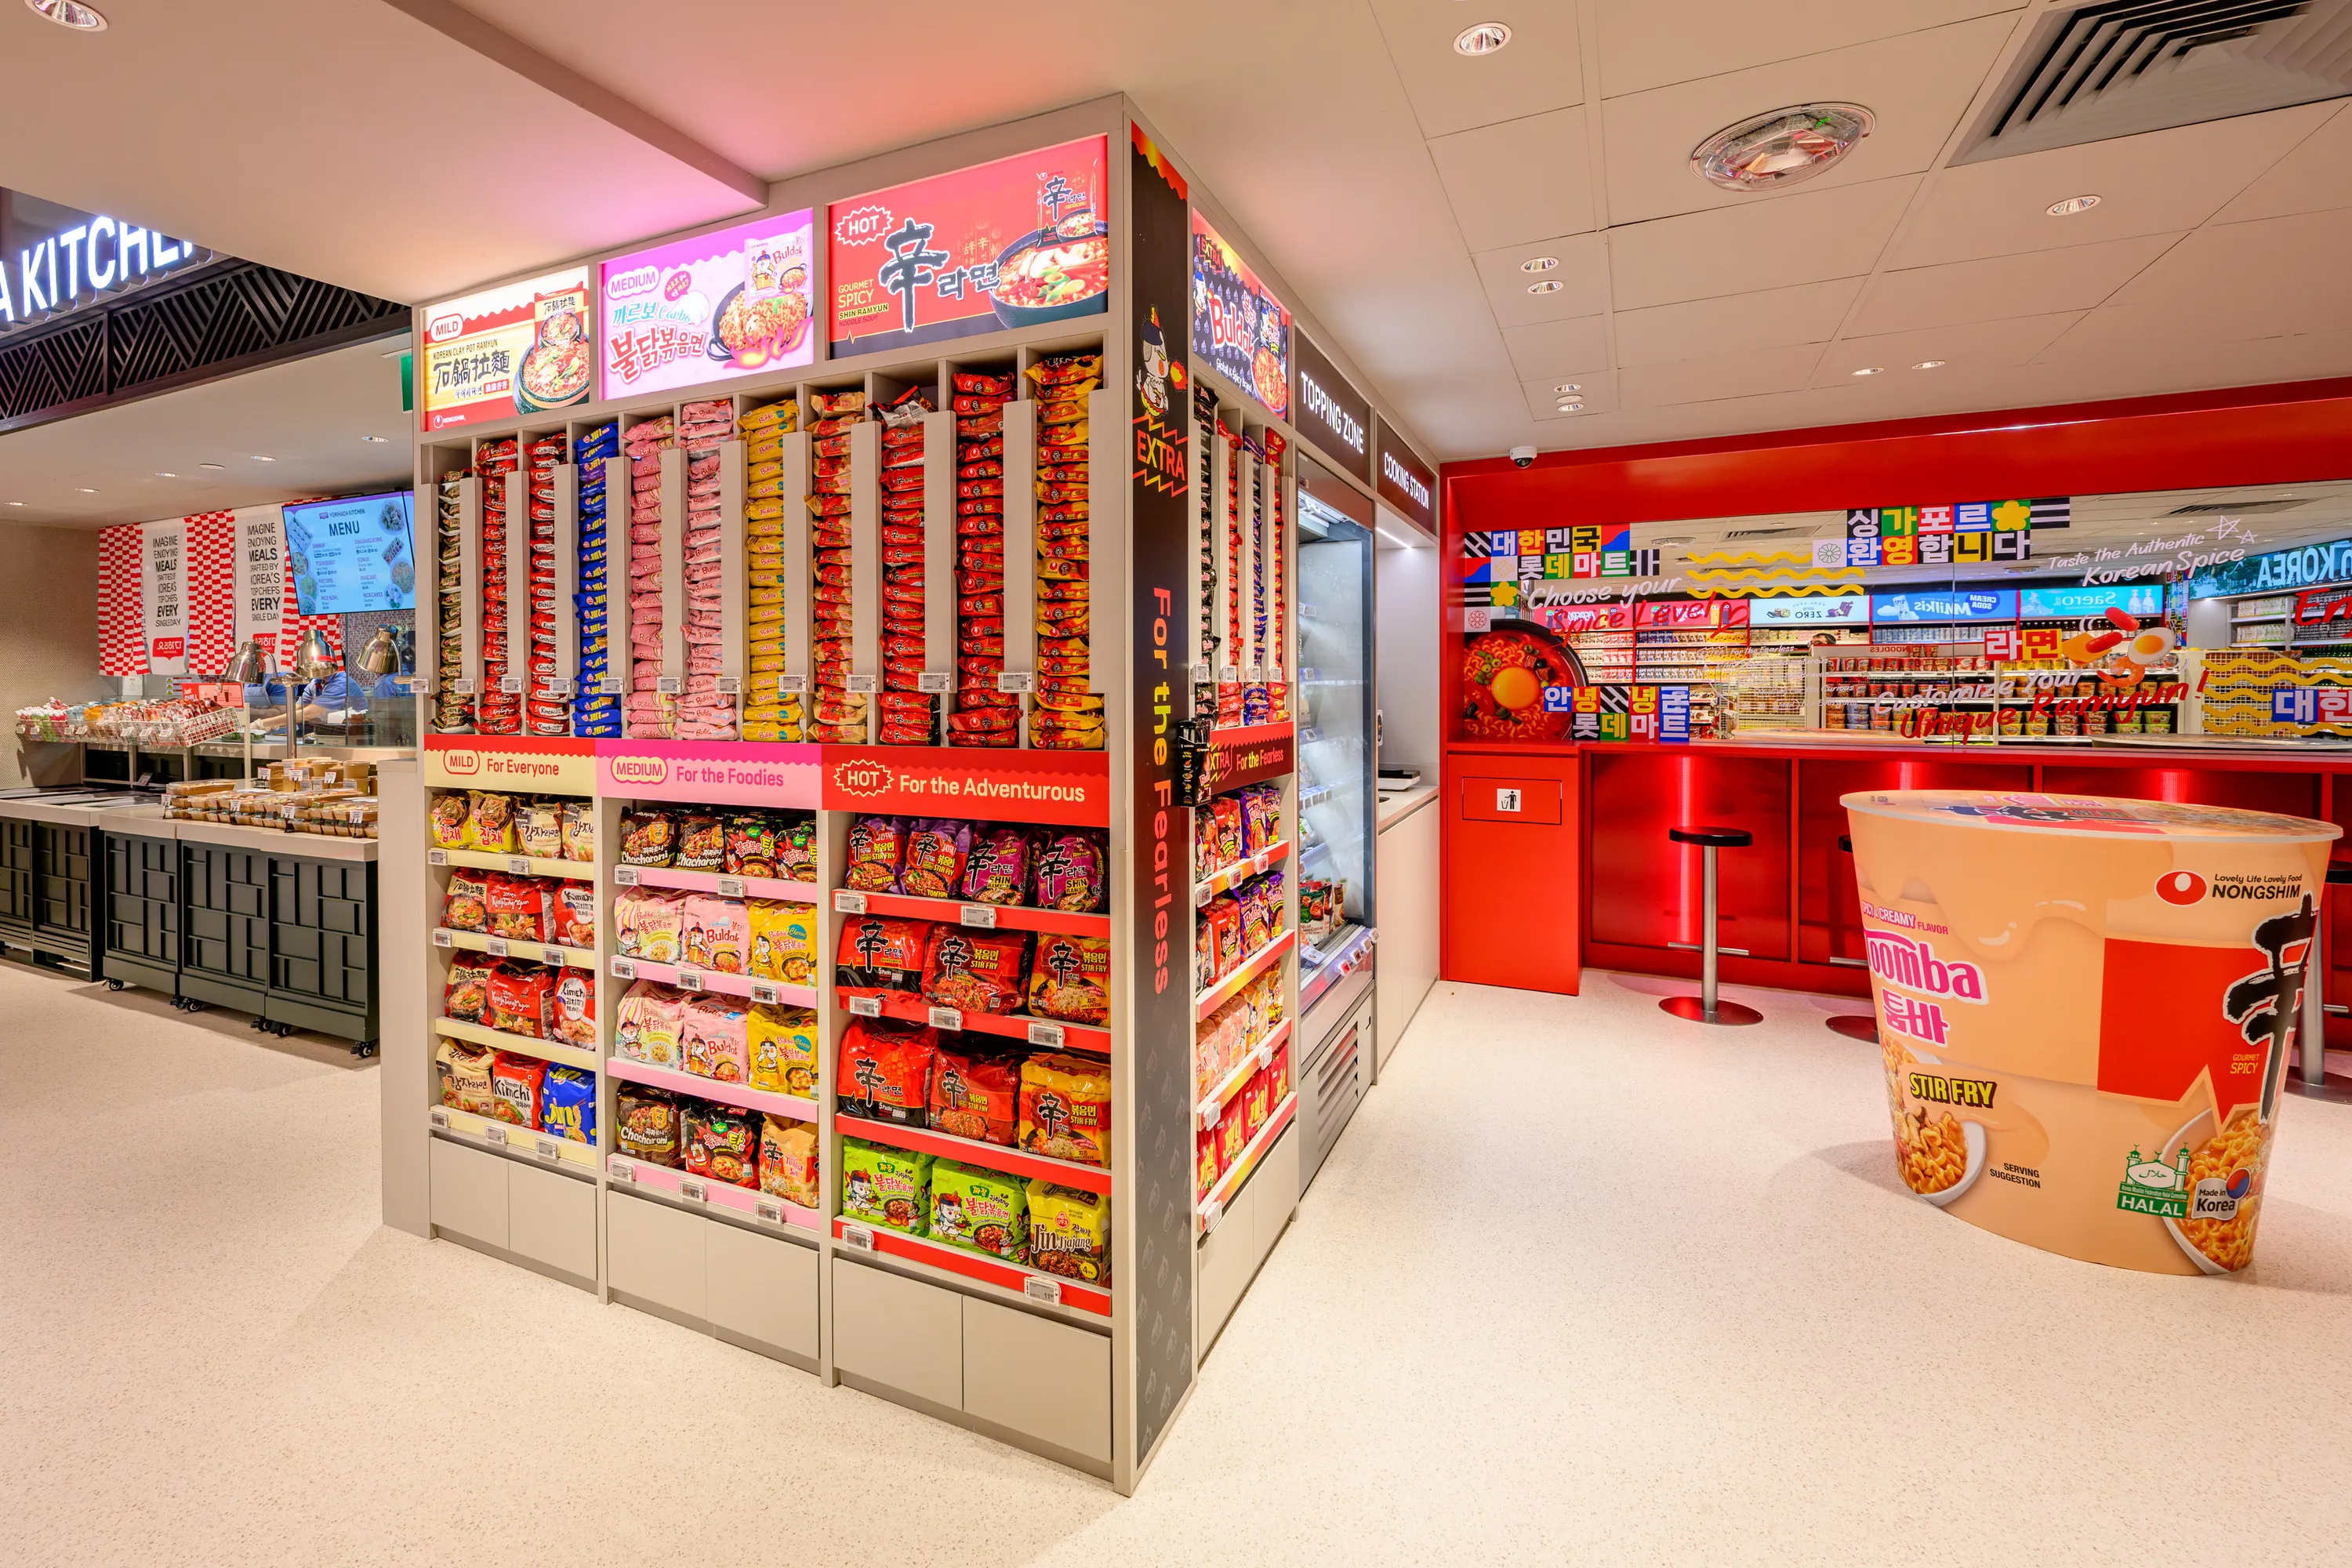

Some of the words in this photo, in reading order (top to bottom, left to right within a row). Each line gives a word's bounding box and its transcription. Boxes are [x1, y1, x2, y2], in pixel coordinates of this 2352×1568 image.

[1044, 176, 1073, 220] 辛
[849, 216, 880, 236] HOT
[611, 271, 656, 293] MEDIUM
[838, 279, 874, 293] GOURMET
[880, 219, 949, 331] 辛
[938, 263, 1000, 299] 라면
[838, 289, 874, 308] SPICY
[612, 302, 655, 325] 까르보
[839, 310, 856, 320] SHIN
[857, 304, 888, 316] RAMYUN
[862, 314, 878, 323] SOUP
[435, 321, 459, 336] MILD
[1210, 295, 1254, 359] Buldak
[433, 348, 452, 360] KOREAN
[452, 346, 465, 357] CLAY
[466, 343, 476, 354] POT
[477, 339, 499, 352] RAMYUN
[610, 327, 706, 381] 불닭볶음면
[1301, 371, 1341, 434] TOPPING
[1343, 412, 1364, 455] ZONE
[1138, 430, 1185, 481] EXTRA
[1384, 452, 1410, 494] COOKING
[1410, 475, 1429, 510] STATION
[247, 523, 276, 535] IMAGINE
[328, 521, 361, 536] MENU
[1848, 503, 1991, 538] 싱가포르
[153, 535, 178, 547] IMAGINE
[1493, 527, 1601, 556] 대한민국
[1847, 532, 2031, 566] 환영합니다
[2049, 553, 2089, 570] Taste
[2094, 547, 2121, 562] the
[2125, 532, 2205, 557] Authentic
[1519, 552, 1627, 580] 롯데마트
[2082, 559, 2173, 587] Korean
[2176, 547, 2245, 579] Spice
[259, 586, 281, 596] CHEFS
[1528, 585, 1612, 609] Choose
[1619, 577, 1682, 609] your
[157, 604, 179, 617] EVERY
[251, 597, 281, 611] EVERY
[1153, 588, 1171, 673] For
[1551, 611, 1625, 648] Spice
[1635, 591, 1717, 626] Level
[1986, 630, 2058, 659] 라면
[1545, 687, 1598, 712] 안녕
[1874, 681, 2014, 714] Customize
[2019, 668, 2082, 695] Your
[1153, 686, 1171, 765] the
[1573, 713, 1688, 739] 롯데마트
[1900, 707, 2016, 745] Unique
[449, 756, 474, 768] MILD
[486, 759, 504, 773] For
[507, 760, 560, 778] Everyone
[1236, 753, 1247, 771] For
[1249, 751, 1259, 769] the
[1260, 747, 1284, 767] Fearless
[616, 761, 663, 777] MEDIUM
[676, 767, 697, 784] For
[700, 767, 724, 785] the
[727, 768, 784, 787] Foodies
[847, 770, 880, 786] HOT
[900, 775, 928, 796] For
[935, 777, 960, 797] the
[964, 778, 1086, 803] Adventurous
[440, 825, 463, 842] 잡채
[480, 827, 503, 846] 잡채
[622, 851, 668, 865] Chacharoni
[967, 840, 997, 891] 辛
[989, 863, 1013, 875] 라면
[989, 876, 1011, 884] SHIN
[1039, 844, 1072, 899] 辛
[1065, 866, 1087, 878] 라면
[2215, 873, 2244, 884] Lovely
[2264, 875, 2287, 884] Lovely
[2288, 873, 2303, 882] Food
[1066, 878, 1087, 888] SHIN
[1153, 781, 1171, 995] Fearless
[2212, 884, 2300, 899] NONGSHIM
[1879, 908, 1915, 928] CREAMY
[1918, 921, 1949, 935] FLAVOR
[706, 929, 739, 943] Buldak
[855, 920, 889, 974] 辛
[940, 936, 970, 981] 辛
[970, 960, 985, 970] STIR
[985, 961, 999, 971] FRY
[974, 948, 1000, 961] 볶음면
[1050, 941, 1080, 989] 辛
[1082, 951, 1107, 963] 볶음면
[1080, 962, 1095, 972] STIR
[1095, 964, 1108, 974] FRY
[1882, 989, 1949, 1046] 툼바
[707, 1039, 739, 1057] Buldak
[2230, 1062, 2259, 1074] SPICY
[494, 1077, 530, 1102] Kimchi
[855, 1056, 886, 1108] 辛
[881, 1085, 902, 1096] 라면
[942, 1069, 967, 1110] 辛
[1910, 1073, 1947, 1101] STIR
[1951, 1080, 1996, 1108] FRY
[967, 1102, 978, 1111] STIR
[978, 1103, 988, 1112] FRY
[968, 1093, 988, 1105] 볶음면
[1038, 1091, 1069, 1140] 辛
[1070, 1116, 1083, 1126] STIR
[1084, 1118, 1098, 1127] FRY
[1071, 1104, 1096, 1117] 볶음면
[620, 1127, 667, 1145] Chacharoni
[1990, 1169, 2041, 1189] SUGGESTION
[2003, 1163, 2040, 1178] SERVING
[873, 1174, 916, 1193] 불닭볶음면
[965, 1197, 1011, 1219] 불닭볶음면
[2121, 1195, 2183, 1216] HALAL
[2197, 1199, 2235, 1212] Korea
[1033, 1223, 1058, 1253] Jin
[1058, 1236, 1091, 1252] Jjajang
